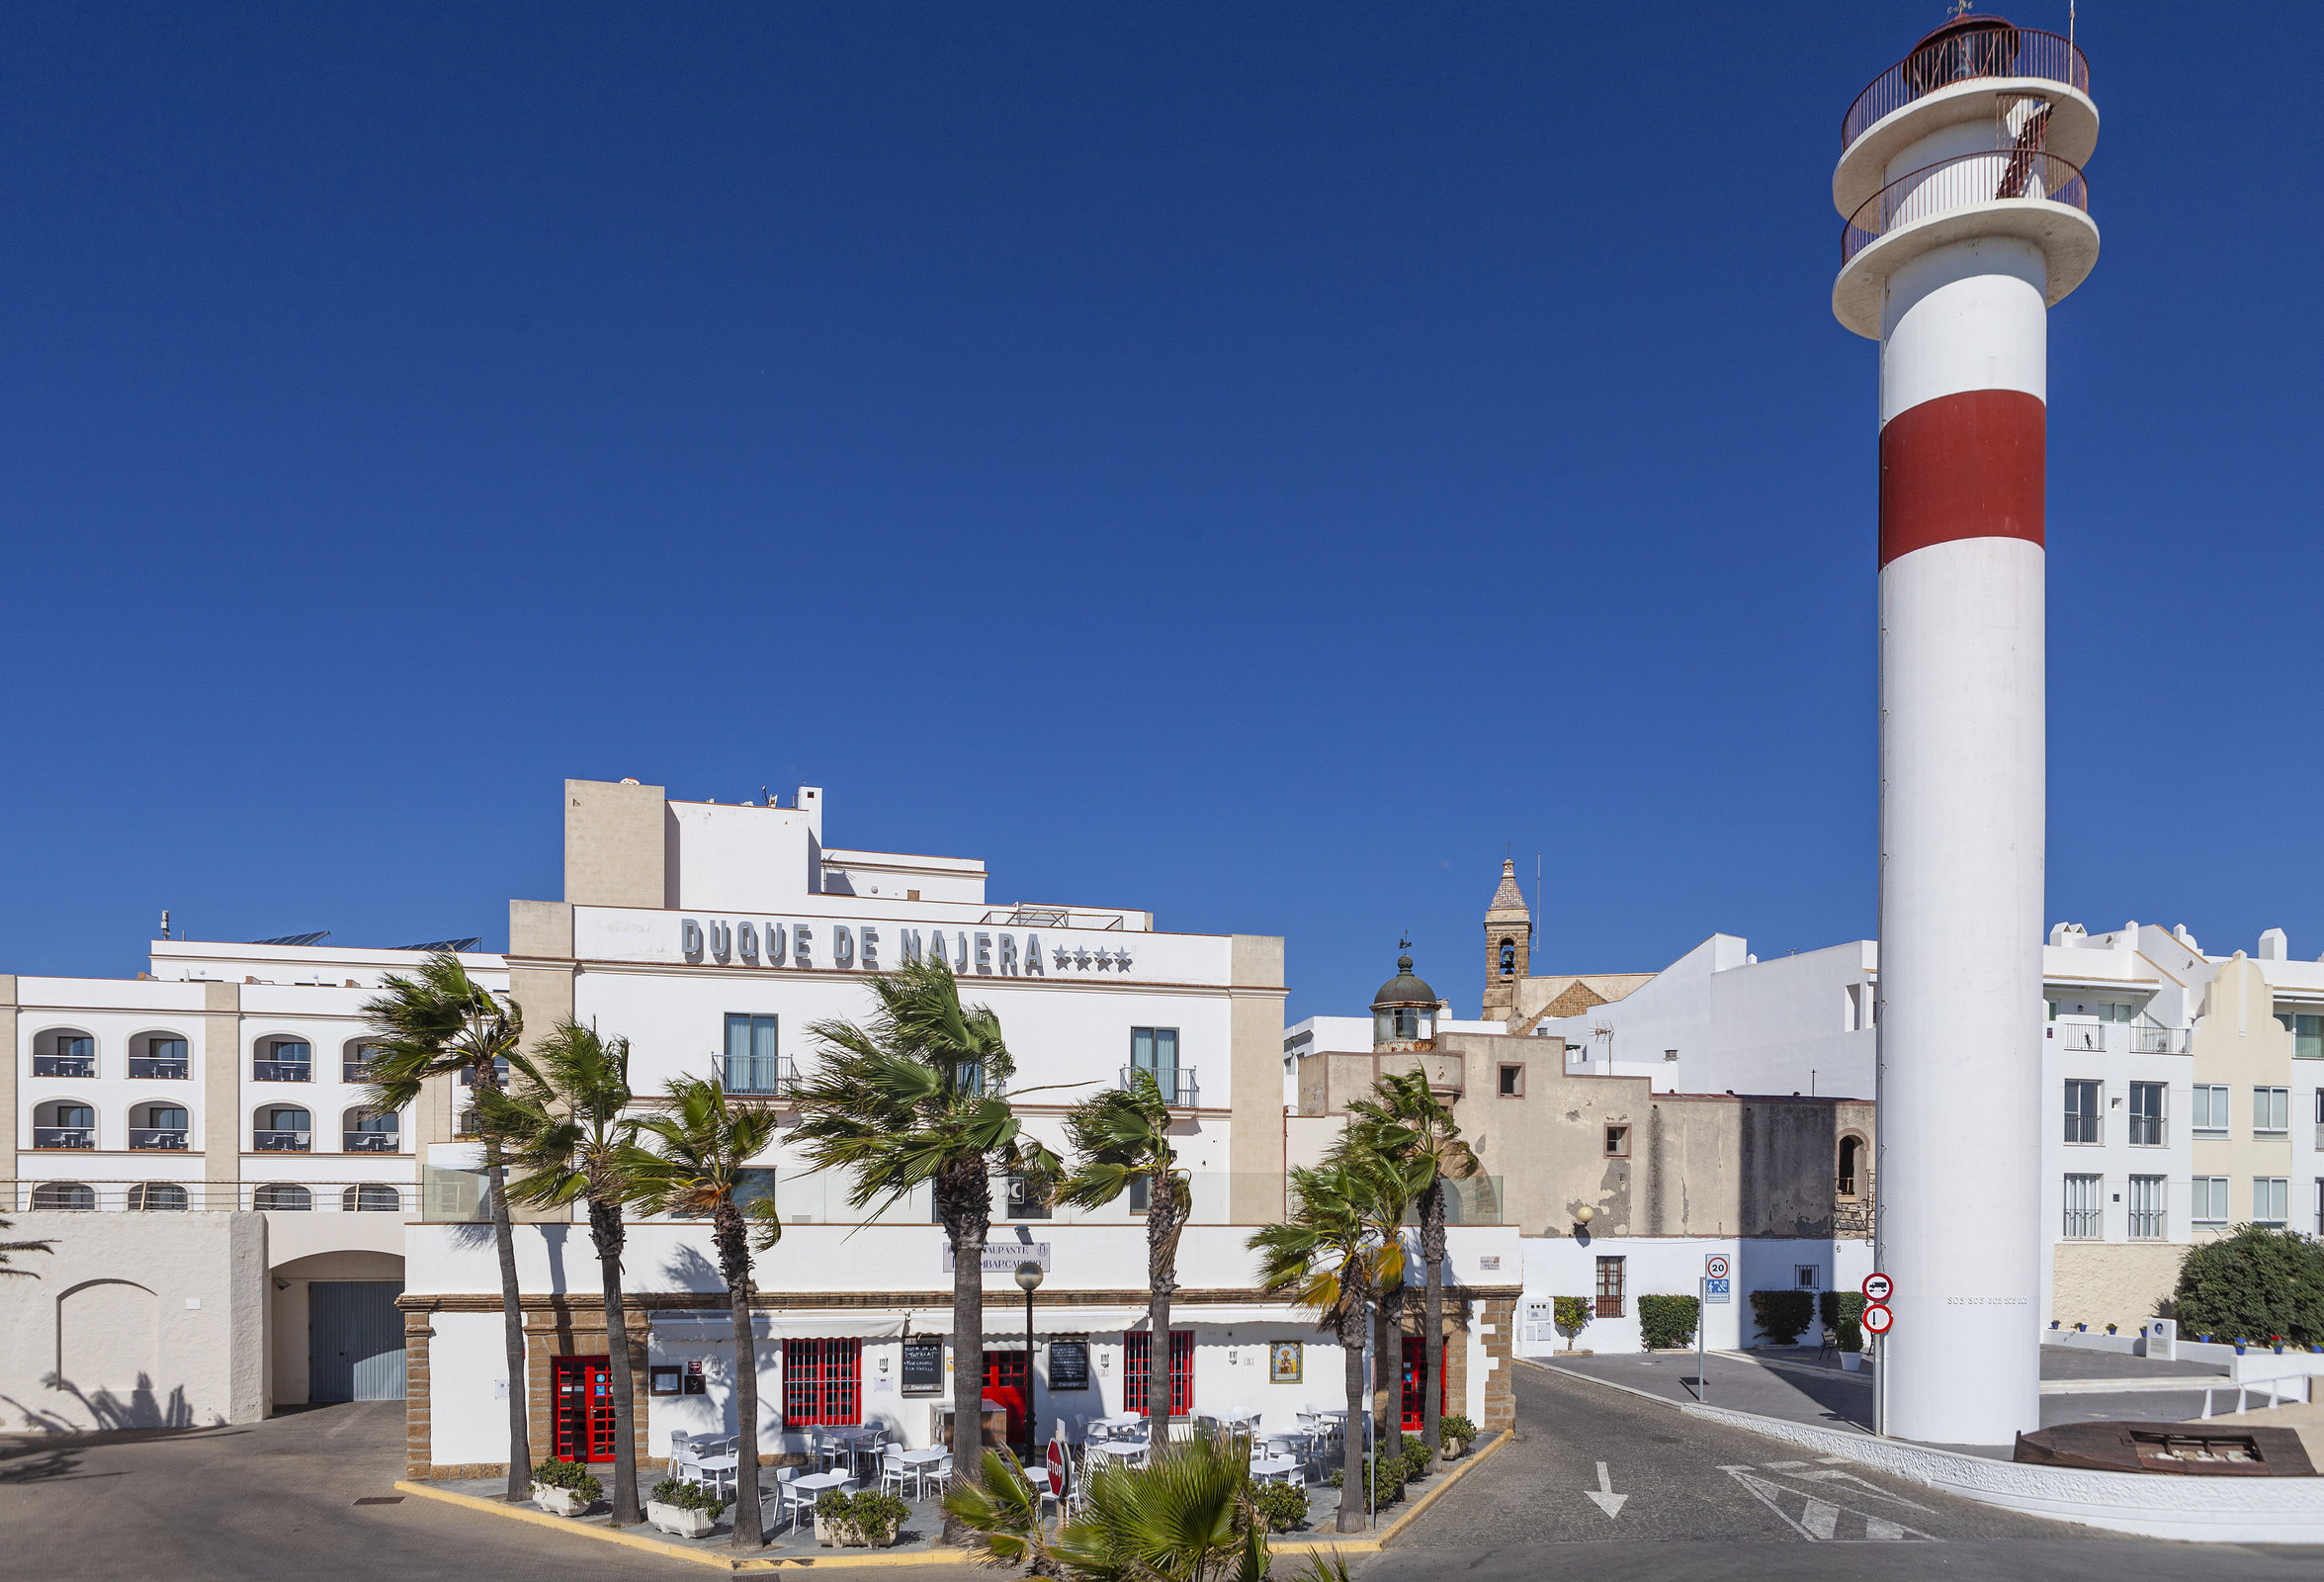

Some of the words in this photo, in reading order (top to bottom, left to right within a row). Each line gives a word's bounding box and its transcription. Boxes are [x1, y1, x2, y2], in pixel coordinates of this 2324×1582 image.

[681, 919, 810, 957] DUQUE
[833, 924, 876, 960] DE
[901, 928, 1042, 966] NAJERA
[1947, 1296, 1964, 1305] SOS
[1967, 1296, 1985, 1305] SOS
[1987, 1296, 2002, 1305] SOS
[2004, 1296, 2017, 1305] SOS
[1048, 1458, 1063, 1478] STOP
